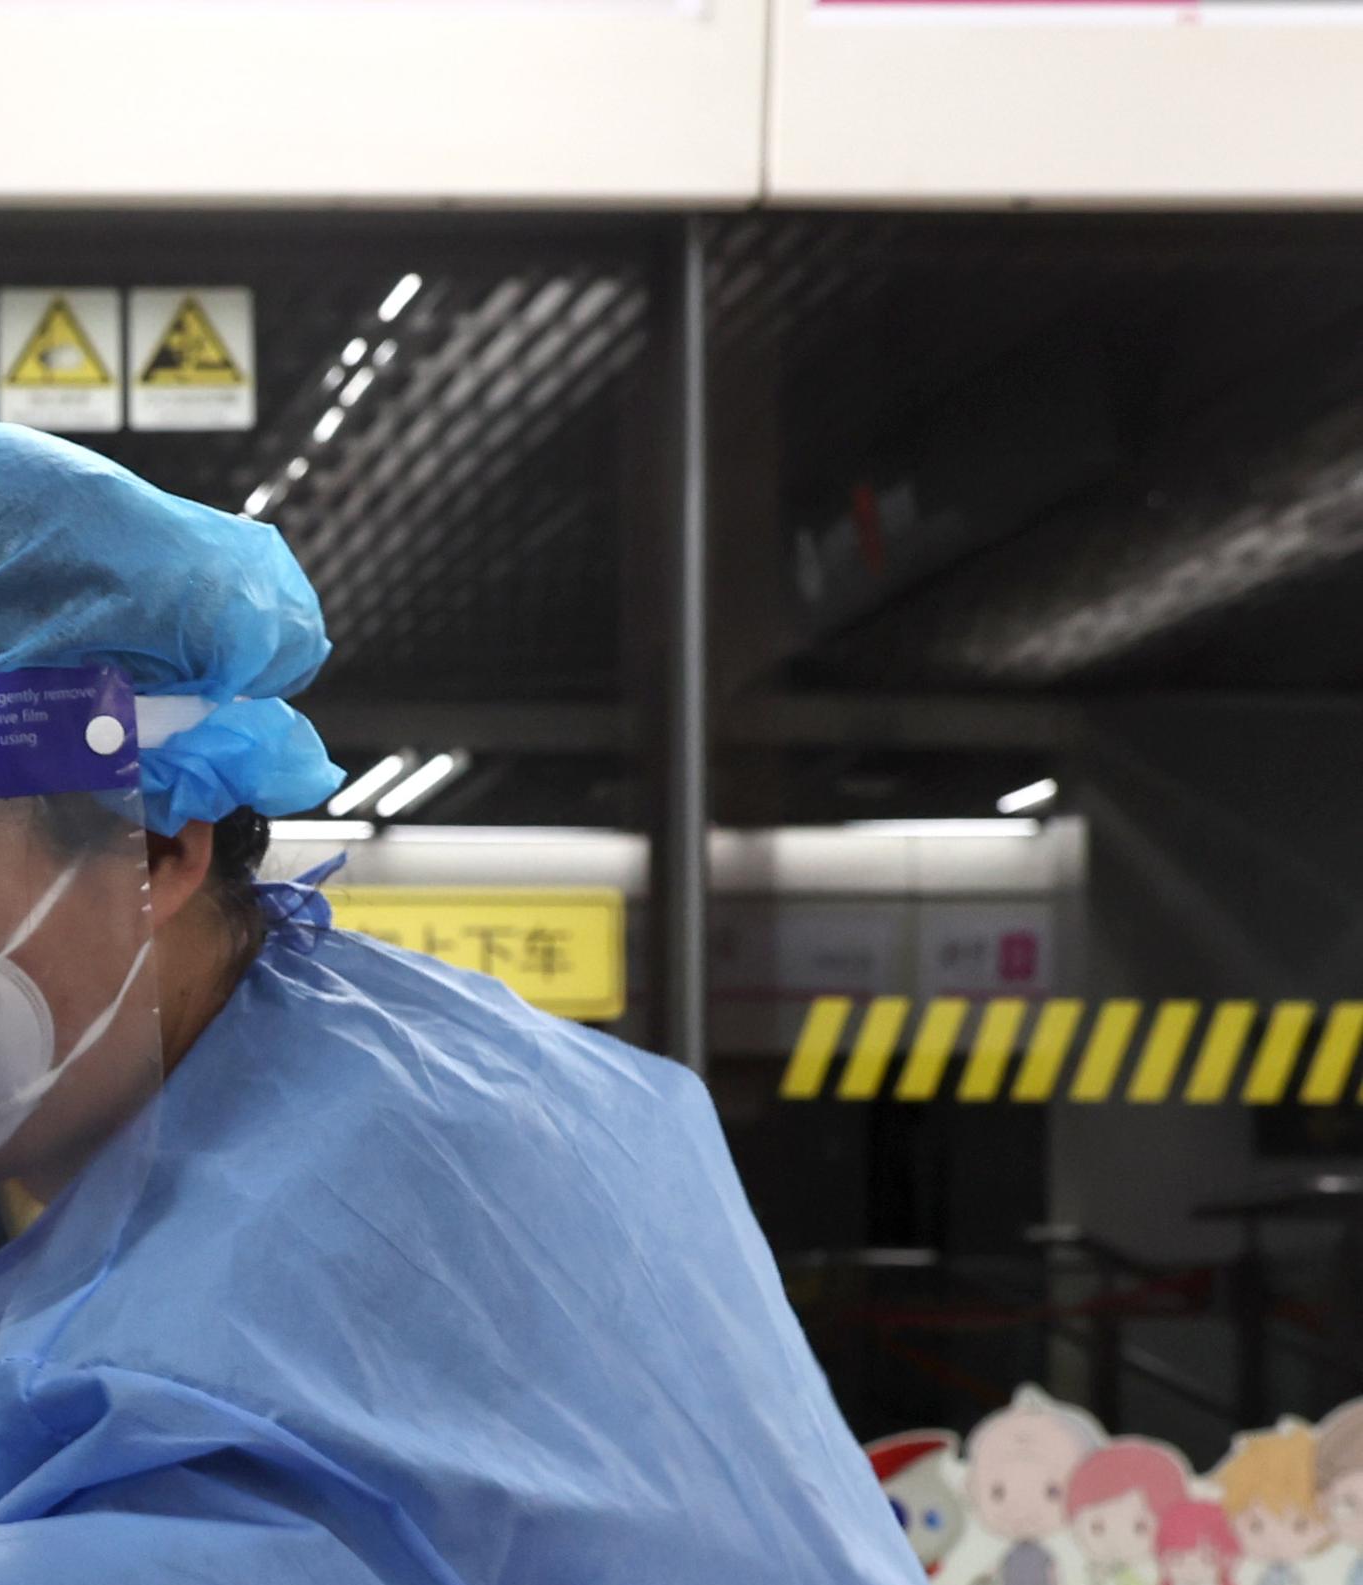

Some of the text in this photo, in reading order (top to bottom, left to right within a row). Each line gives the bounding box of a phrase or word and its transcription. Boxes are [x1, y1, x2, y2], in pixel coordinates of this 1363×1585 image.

[43, 687, 96, 701] remove
[22, 709, 49, 723] film
[0, 732, 38, 748] using
